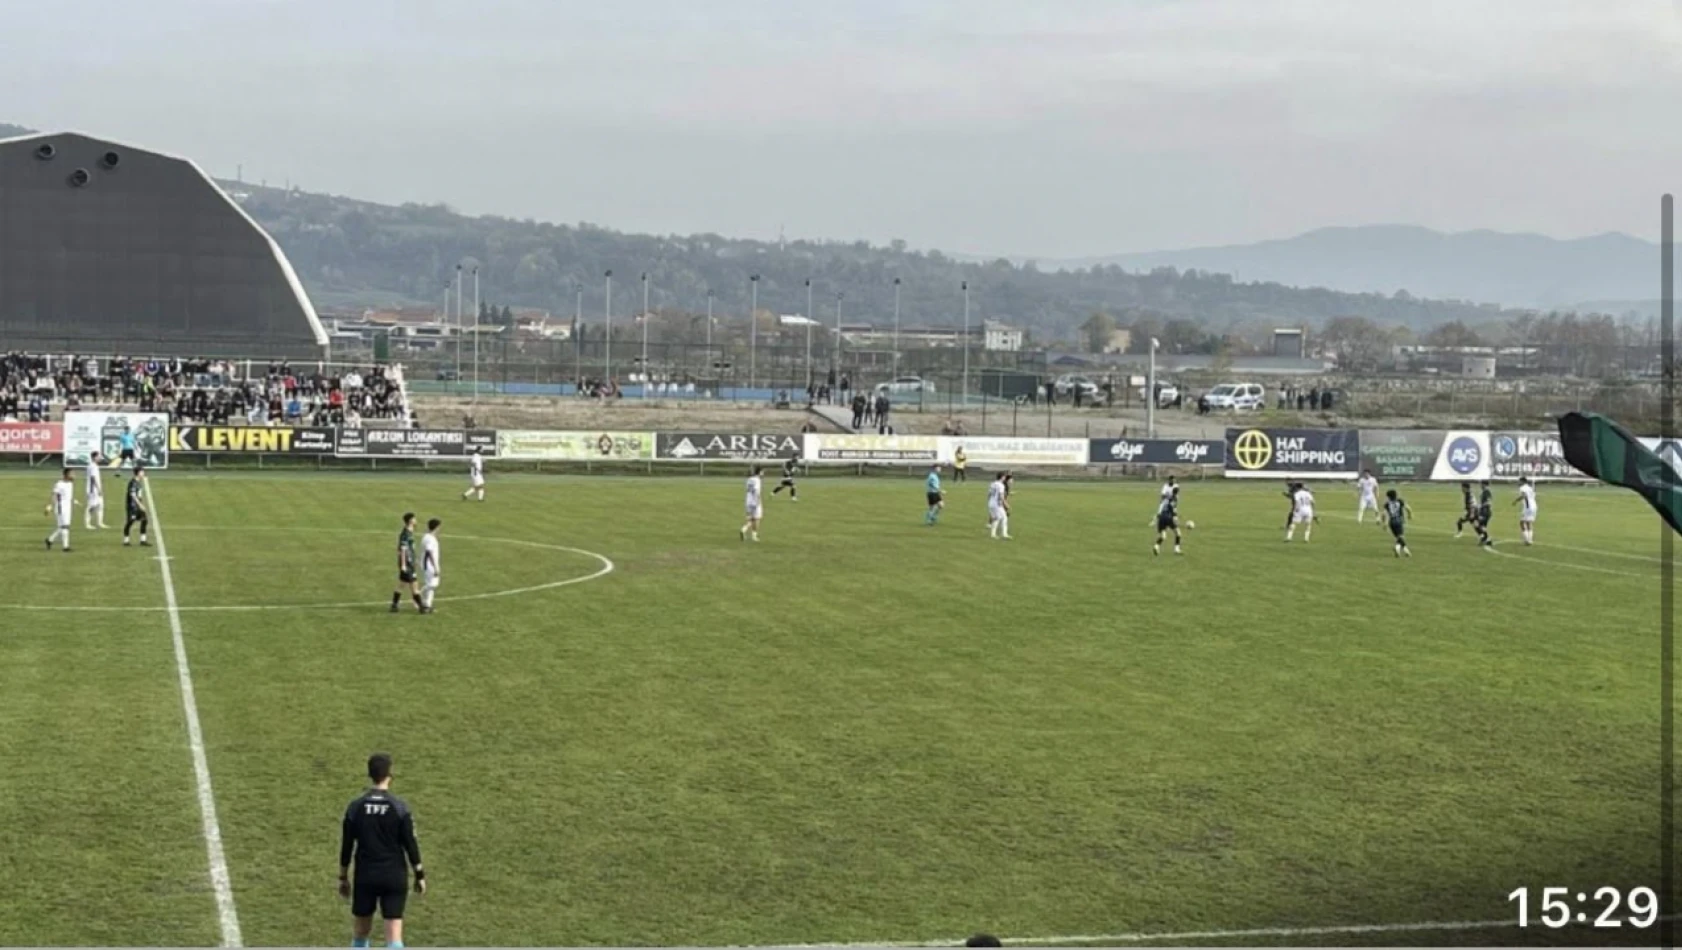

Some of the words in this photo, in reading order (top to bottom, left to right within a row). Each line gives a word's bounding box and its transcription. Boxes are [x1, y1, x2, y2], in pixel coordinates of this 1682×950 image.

[198, 427, 293, 451] LEVENT
[1276, 437, 1305, 450] HAT
[1276, 451, 1345, 464] SHIPPING
[1451, 448, 1478, 462] AVS
